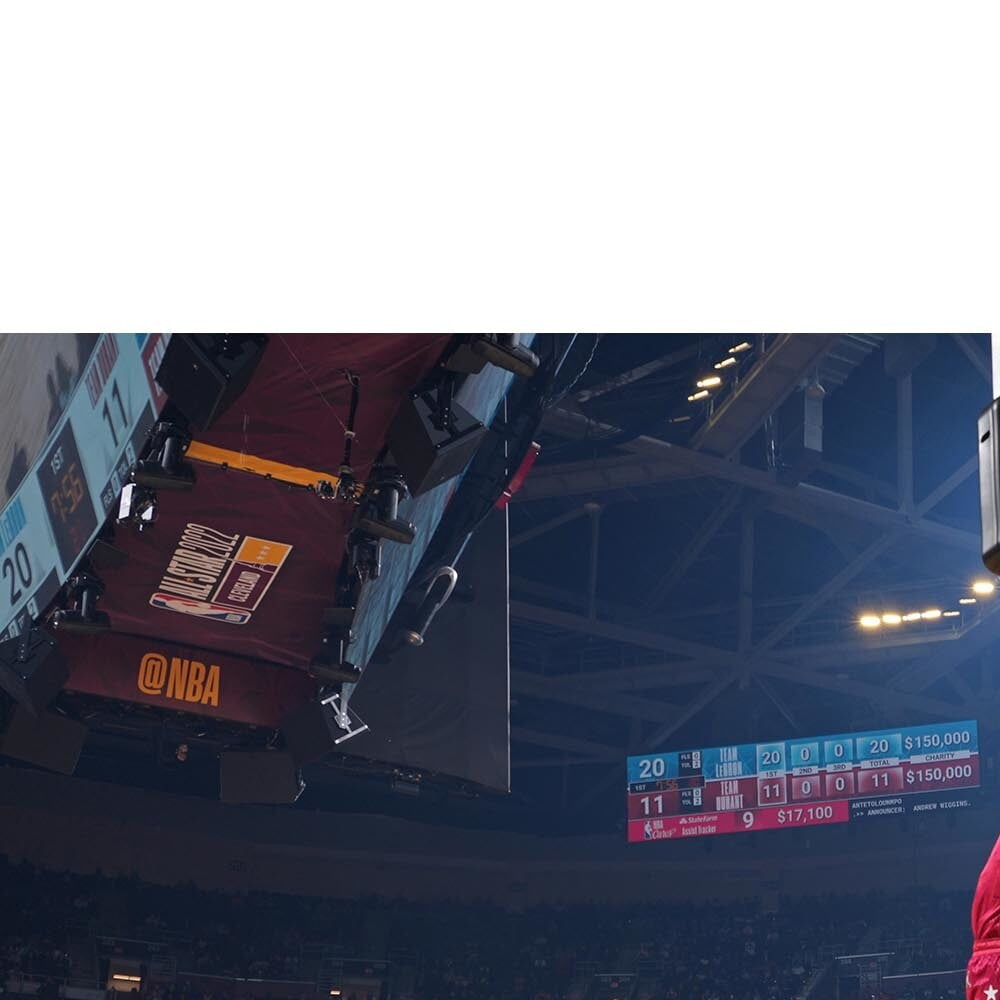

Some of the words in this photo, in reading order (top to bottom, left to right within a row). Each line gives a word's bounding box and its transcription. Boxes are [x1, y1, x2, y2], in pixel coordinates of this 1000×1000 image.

[102, 377, 129, 448] 11
[3, 542, 32, 606] 20
[137, 652, 221, 707] @NBA
[719, 747, 738, 763] TEAM
[762, 751, 780, 765] 20
[801, 747, 810, 760] 0
[834, 744, 844, 757] 0
[870, 739, 889, 754] 20
[904, 731, 970, 750] $150,000
[639, 757, 665, 779] 20
[869, 759, 890, 767] TOTAL
[925, 753, 955, 761] CHARITY
[720, 780, 739, 795] TEAM
[763, 784, 780, 799] 11
[802, 781, 811, 794] 0
[835, 777, 845, 791] 0
[871, 772, 889, 787] 11
[906, 765, 972, 784] $150,000
[640, 795, 663, 815] 11
[715, 794, 744, 811] DURANT
[743, 811, 754, 829] 9
[777, 806, 833, 825] $17,100
